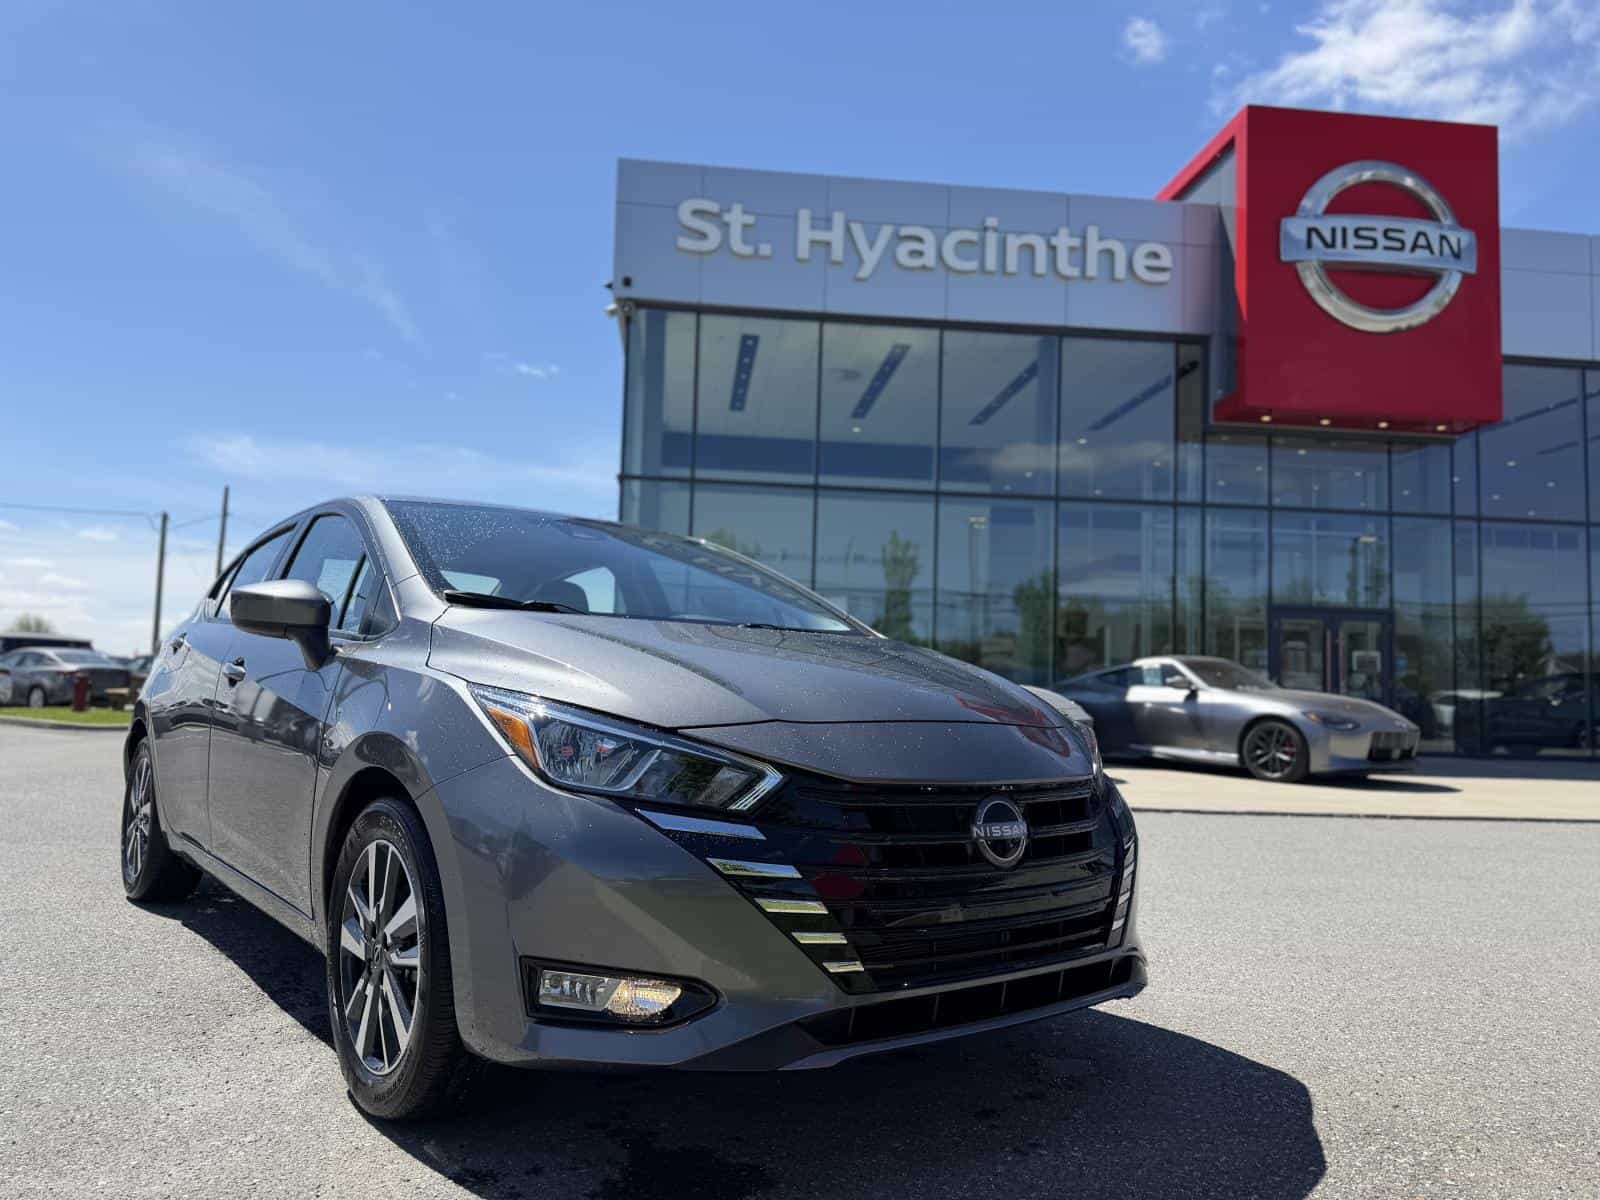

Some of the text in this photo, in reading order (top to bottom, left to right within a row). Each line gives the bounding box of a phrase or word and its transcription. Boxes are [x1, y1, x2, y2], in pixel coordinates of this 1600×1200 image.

[676, 198, 1174, 284] St. Hyacinthe
[1306, 225, 1462, 261] NISSAN
[972, 824, 1028, 838] NISSAN
